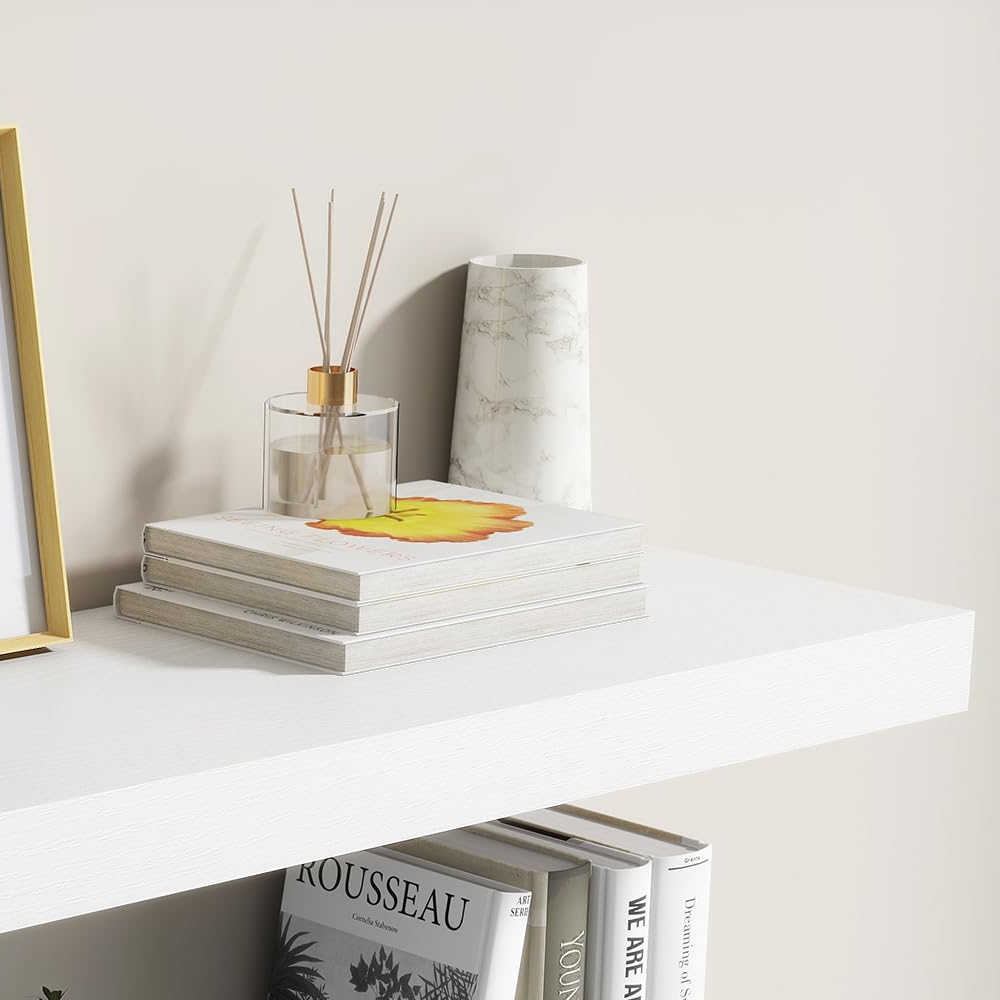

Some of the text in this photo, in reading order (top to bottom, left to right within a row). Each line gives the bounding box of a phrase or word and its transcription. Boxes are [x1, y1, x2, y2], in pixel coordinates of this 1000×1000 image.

[296, 856, 471, 931] ROUSSEAU
[627, 894, 647, 931] WE
[352, 912, 374, 926] Cornelia
[678, 897, 696, 969] Dreaming
[625, 937, 645, 978] ARE
[680, 971, 692, 985] of
